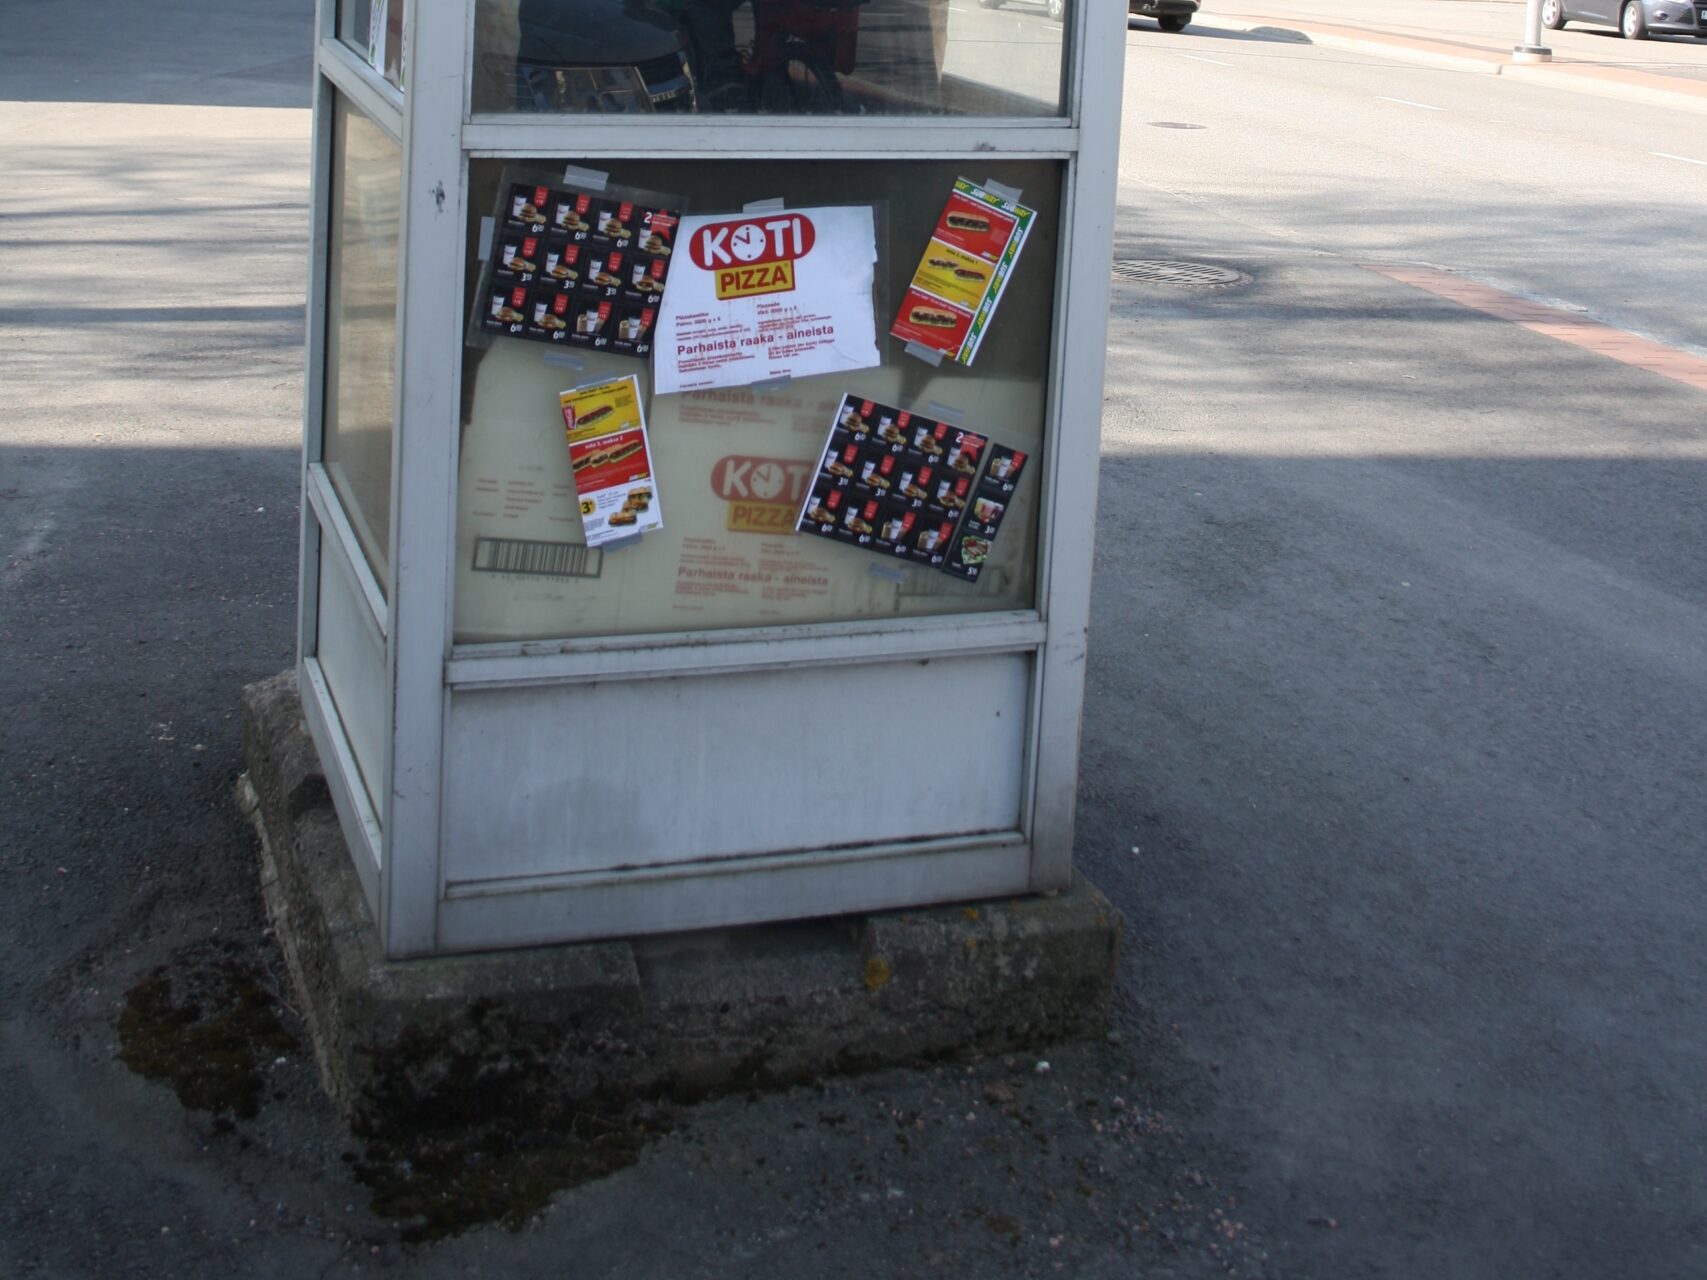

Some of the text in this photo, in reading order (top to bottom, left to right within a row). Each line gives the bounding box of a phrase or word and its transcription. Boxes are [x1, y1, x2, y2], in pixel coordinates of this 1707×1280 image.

[970, 187, 1000, 204] SUBWAY
[702, 218, 803, 267] KOTI
[720, 266, 788, 293] PIZZA
[677, 339, 737, 355] Parhaista
[740, 334, 774, 347] raaka
[786, 325, 834, 340] aineista
[722, 458, 808, 500] KOT
[732, 505, 796, 527] PIZZA
[677, 565, 736, 580] Parhaista
